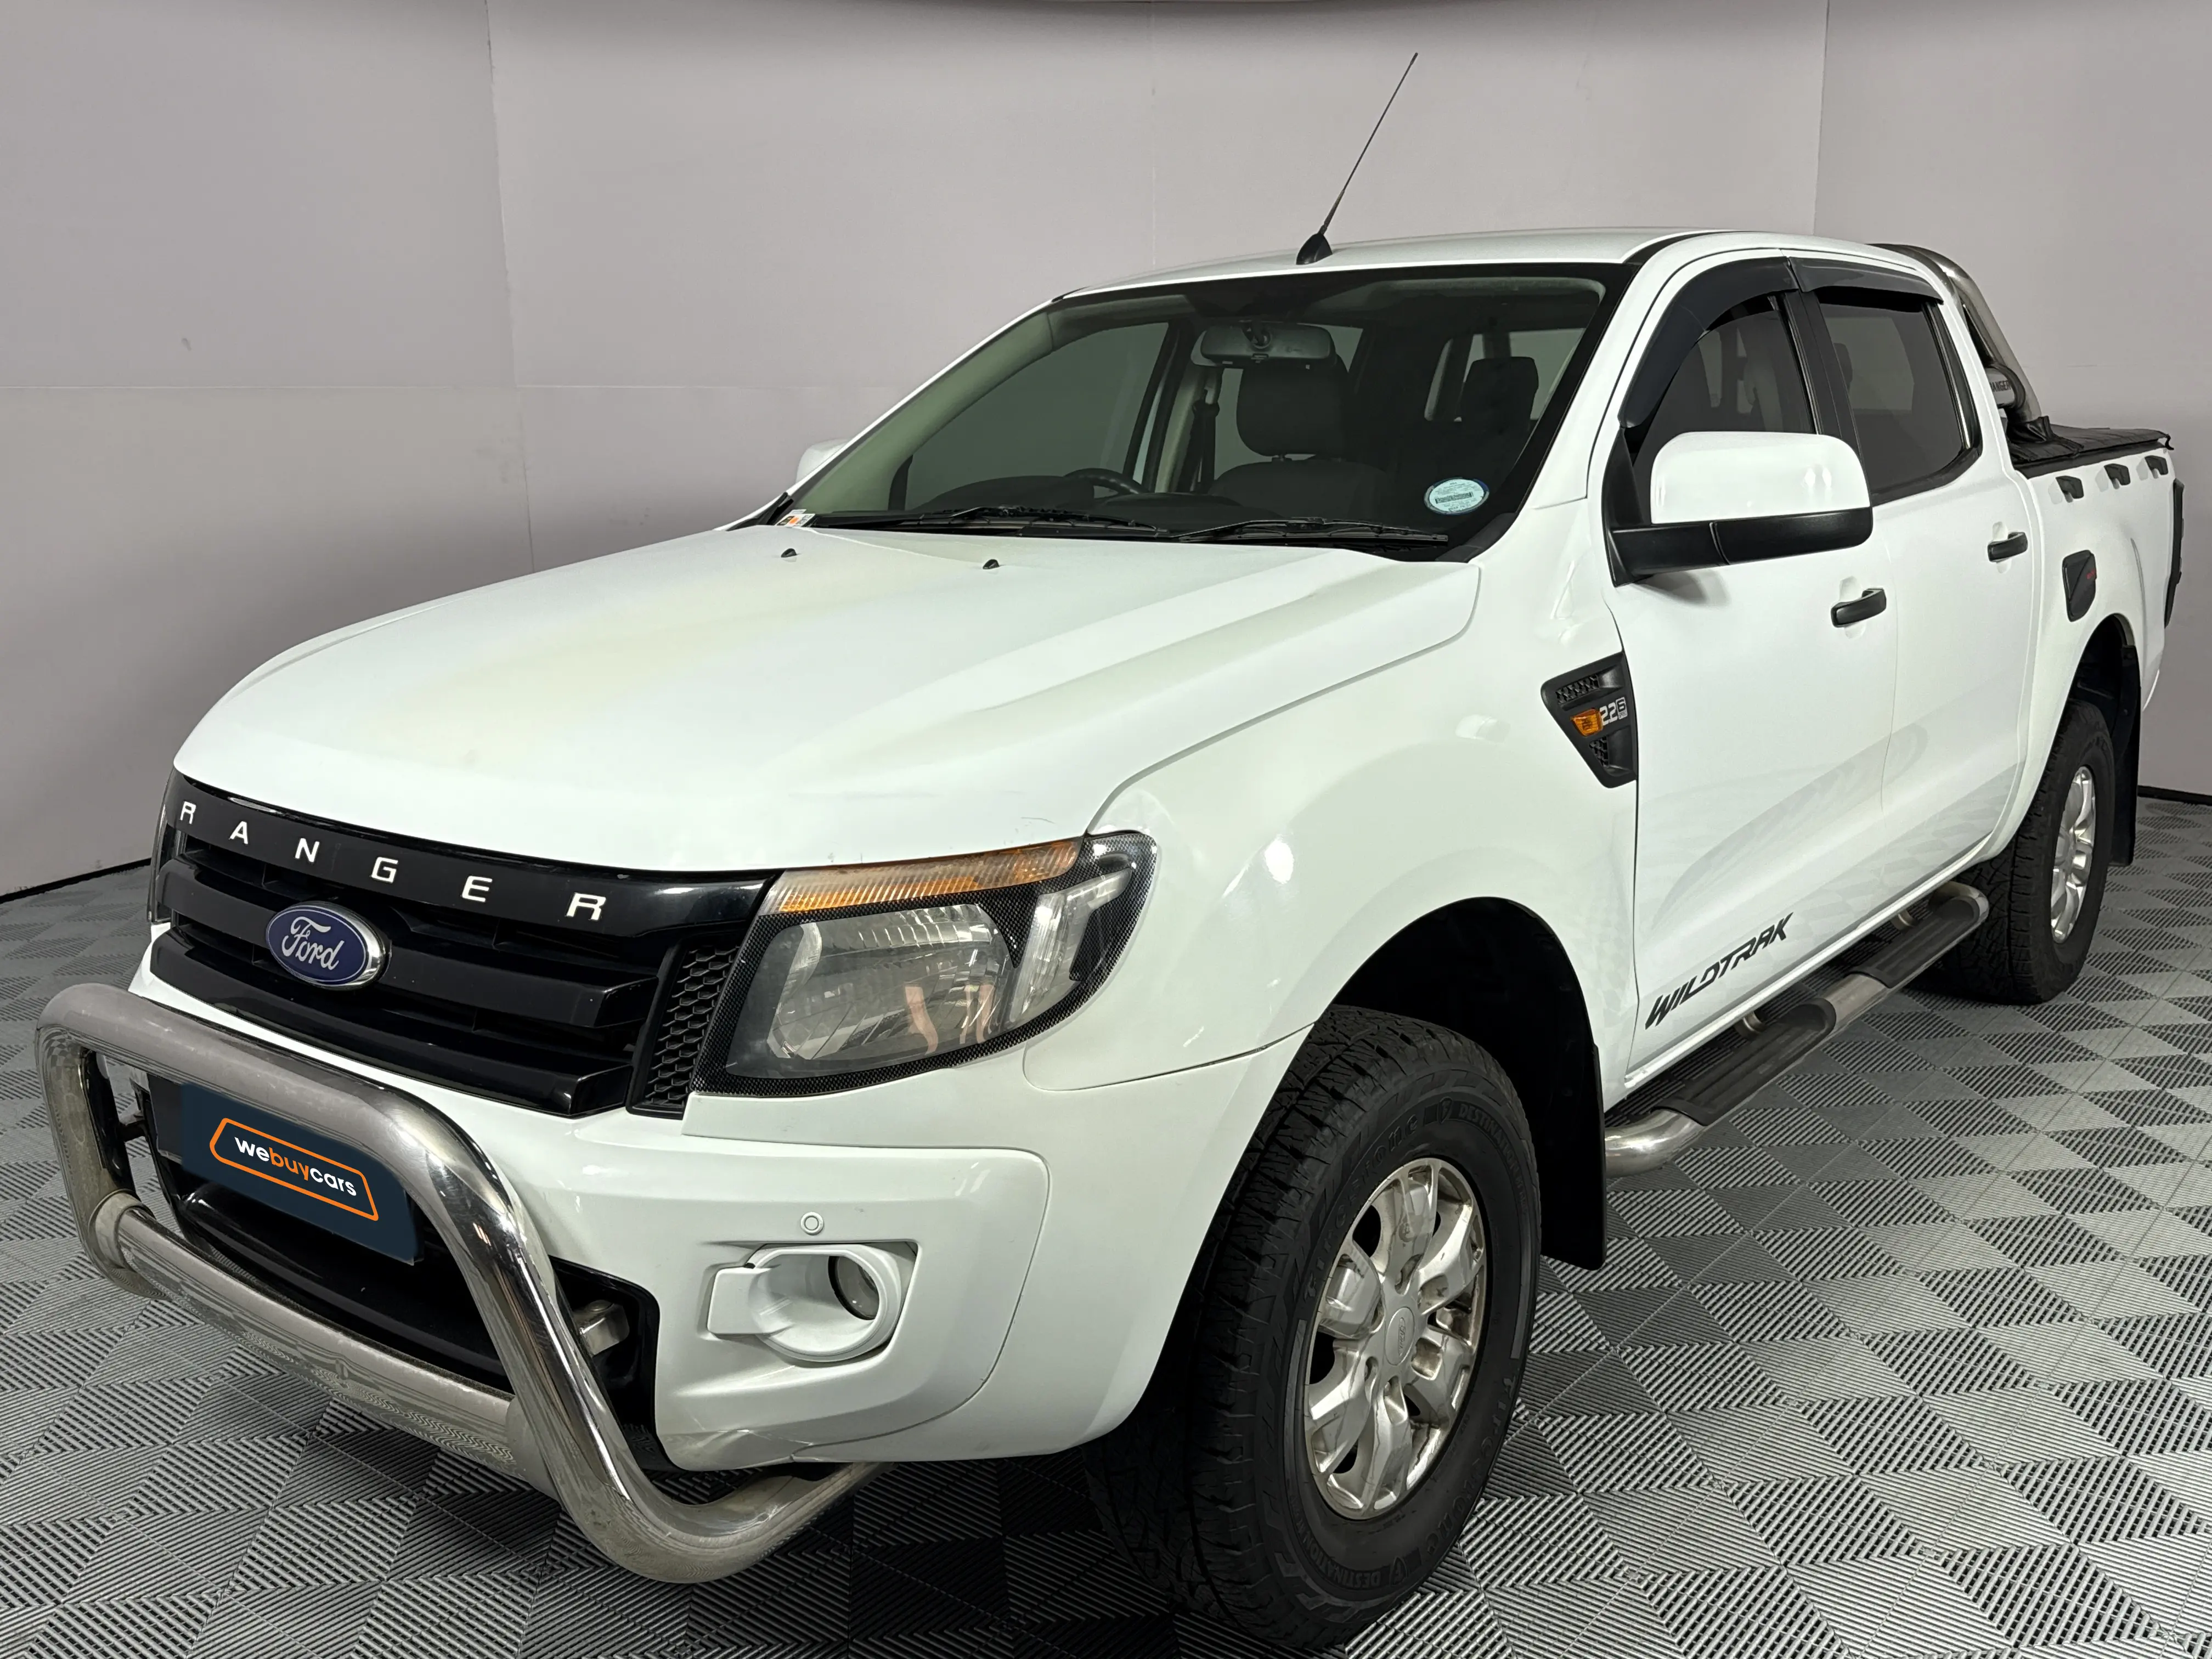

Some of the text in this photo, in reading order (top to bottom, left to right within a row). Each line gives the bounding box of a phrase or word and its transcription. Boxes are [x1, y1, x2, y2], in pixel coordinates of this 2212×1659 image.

[179, 800, 606, 921] RANGER
[281, 916, 344, 971] Ford
[1645, 912, 1794, 1030] WILDTRAK
